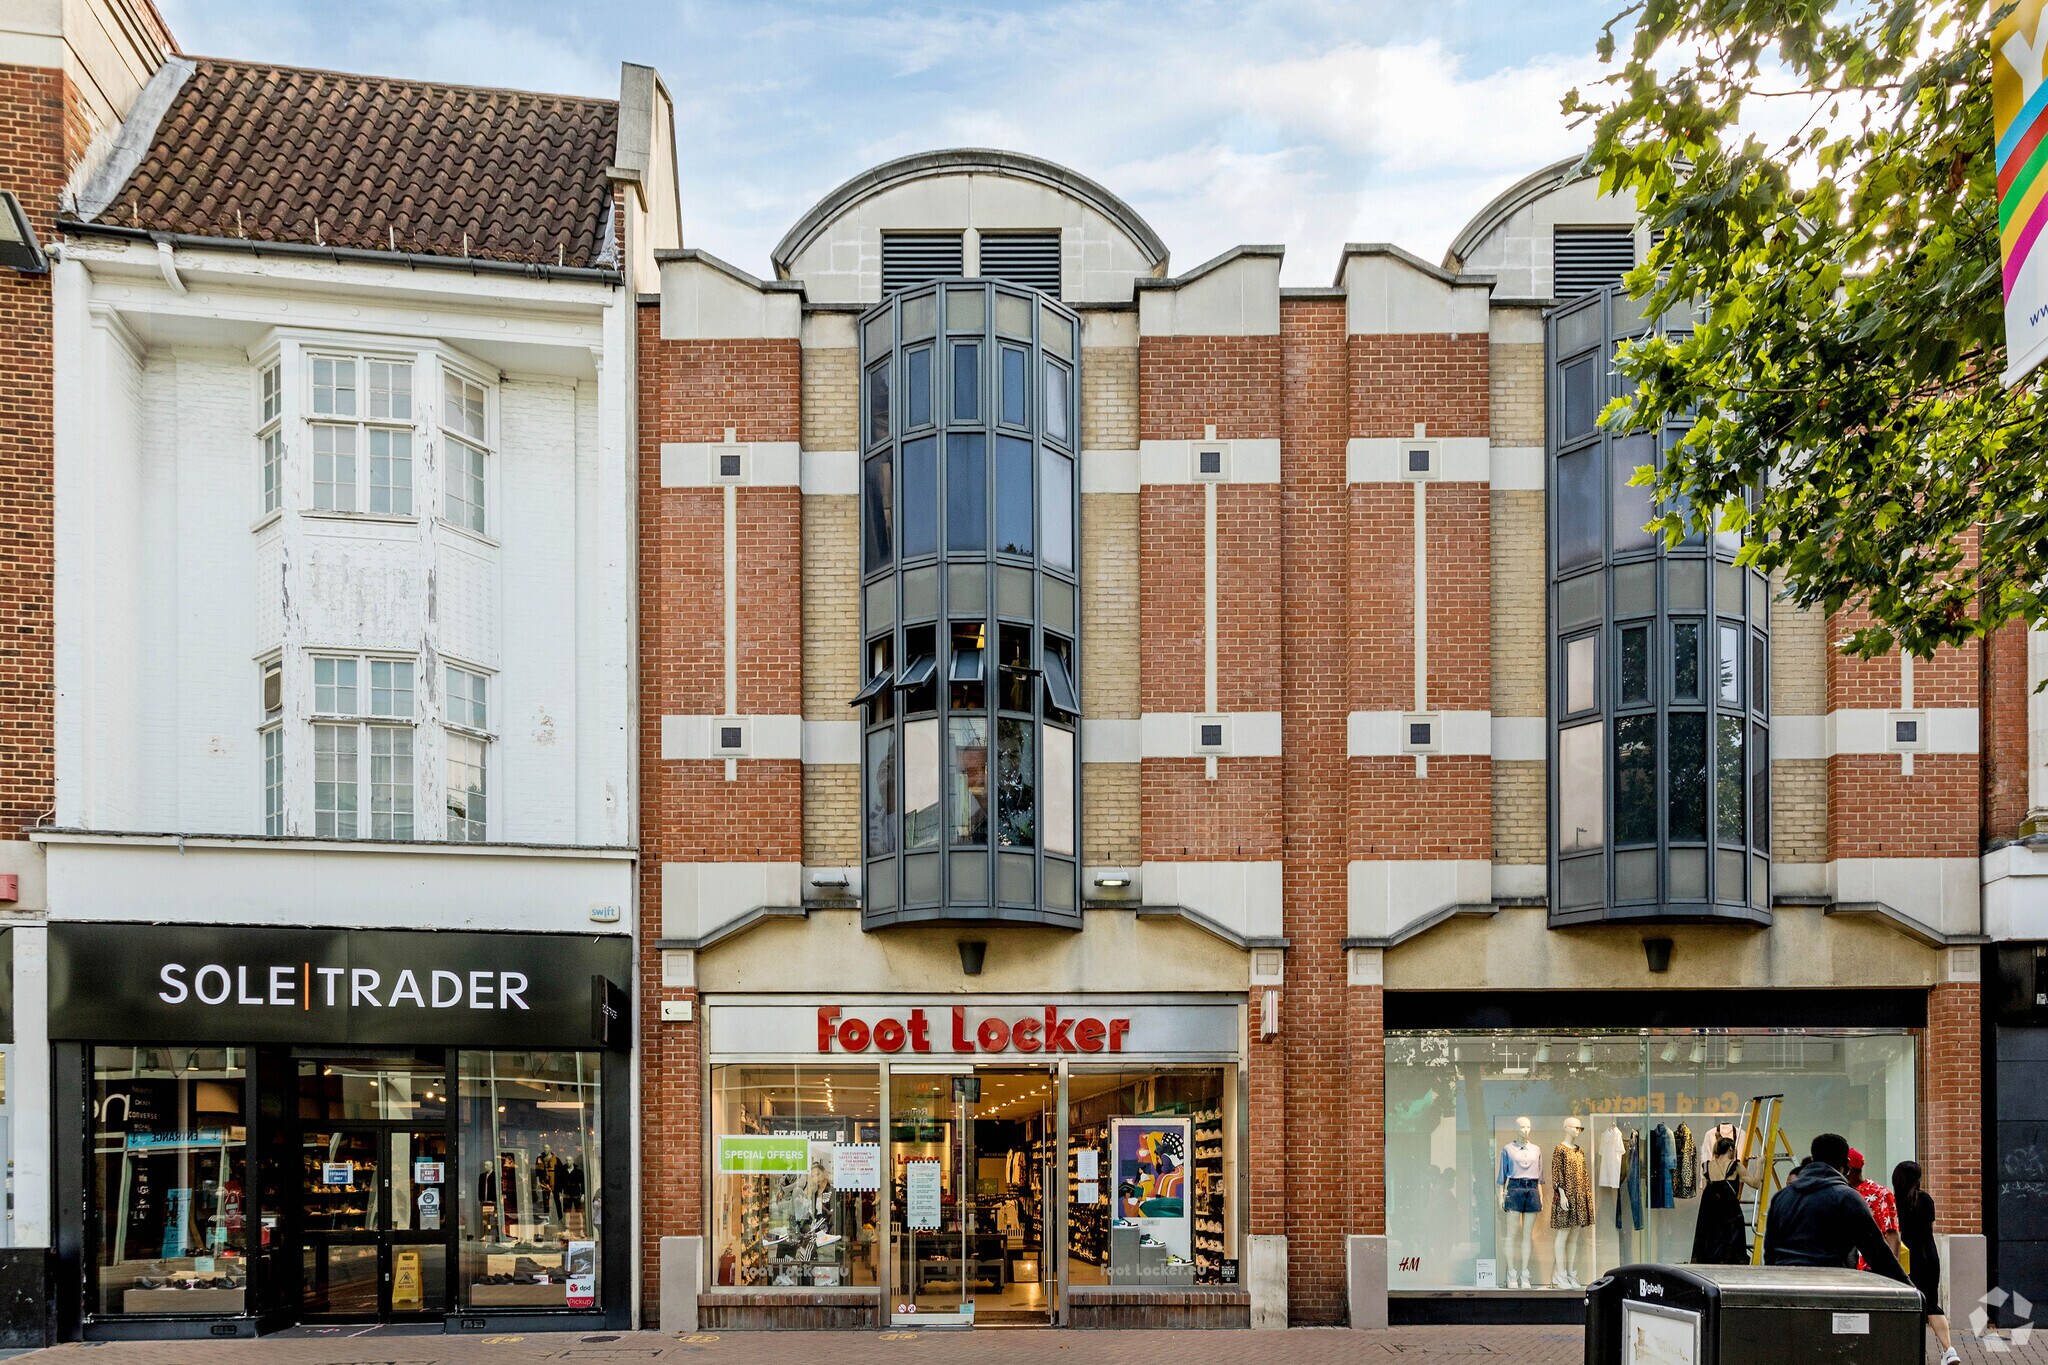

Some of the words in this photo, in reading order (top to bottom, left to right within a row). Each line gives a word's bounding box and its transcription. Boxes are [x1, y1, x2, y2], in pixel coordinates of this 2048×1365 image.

[591, 905, 616, 918] swift
[159, 963, 296, 1006] SOLE
[316, 967, 531, 1010] TRADER
[817, 1005, 932, 1053] Foot
[951, 1005, 1131, 1053] Locker
[724, 1150, 765, 1160] SPECIAL
[766, 1150, 804, 1160] OFFERS
[779, 1264, 849, 1277] Locku
[1100, 1263, 1131, 1277] Foot
[1639, 1279, 1664, 1297] Bigbelly
[569, 1298, 592, 1306] Pickup
